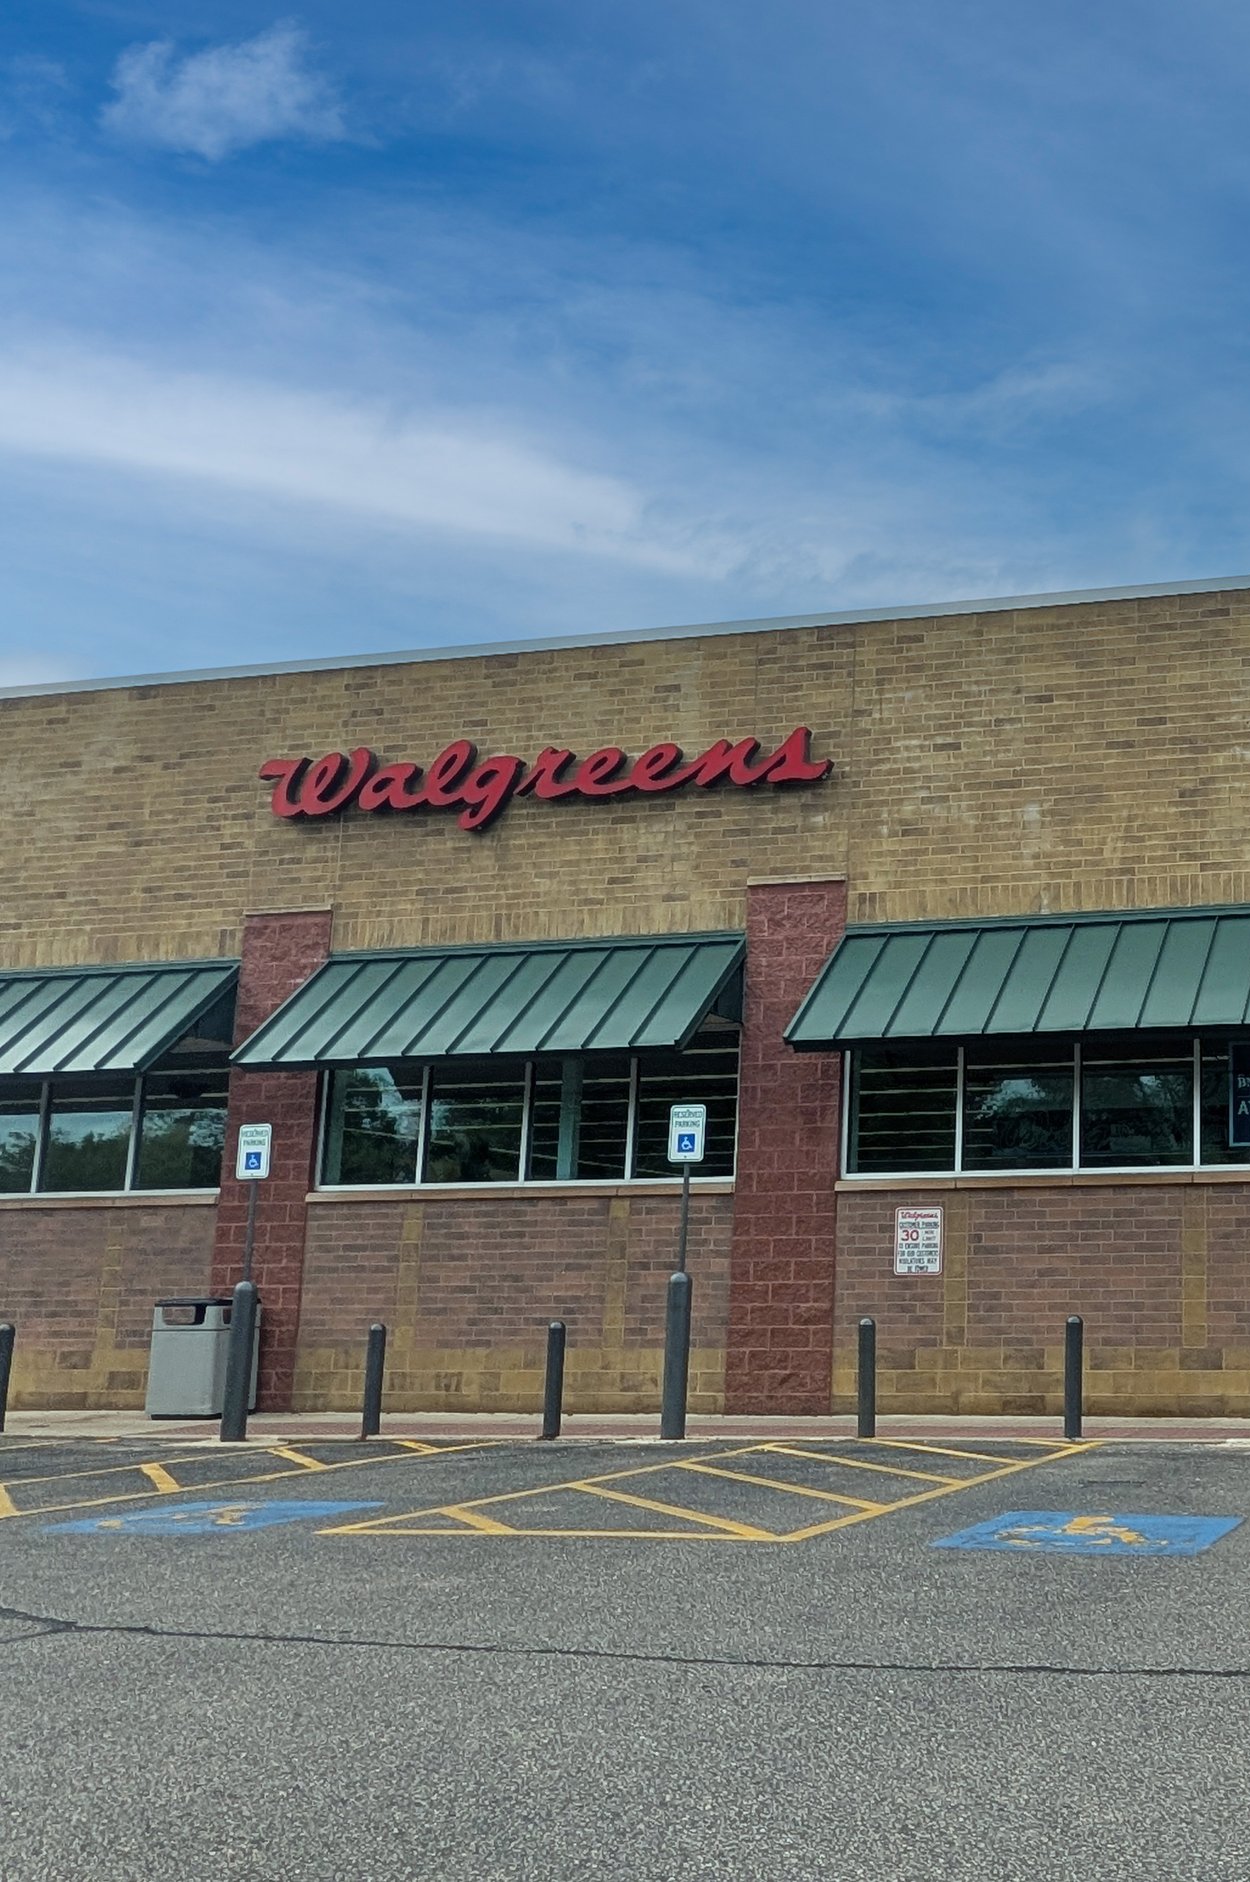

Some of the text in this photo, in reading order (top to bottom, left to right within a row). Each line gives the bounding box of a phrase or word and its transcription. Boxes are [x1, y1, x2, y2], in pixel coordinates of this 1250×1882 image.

[259, 726, 832, 832] Walgreens
[675, 1120, 700, 1128] PARKING
[900, 1211, 938, 1221] Walgreens
[901, 1230, 920, 1241] 30
